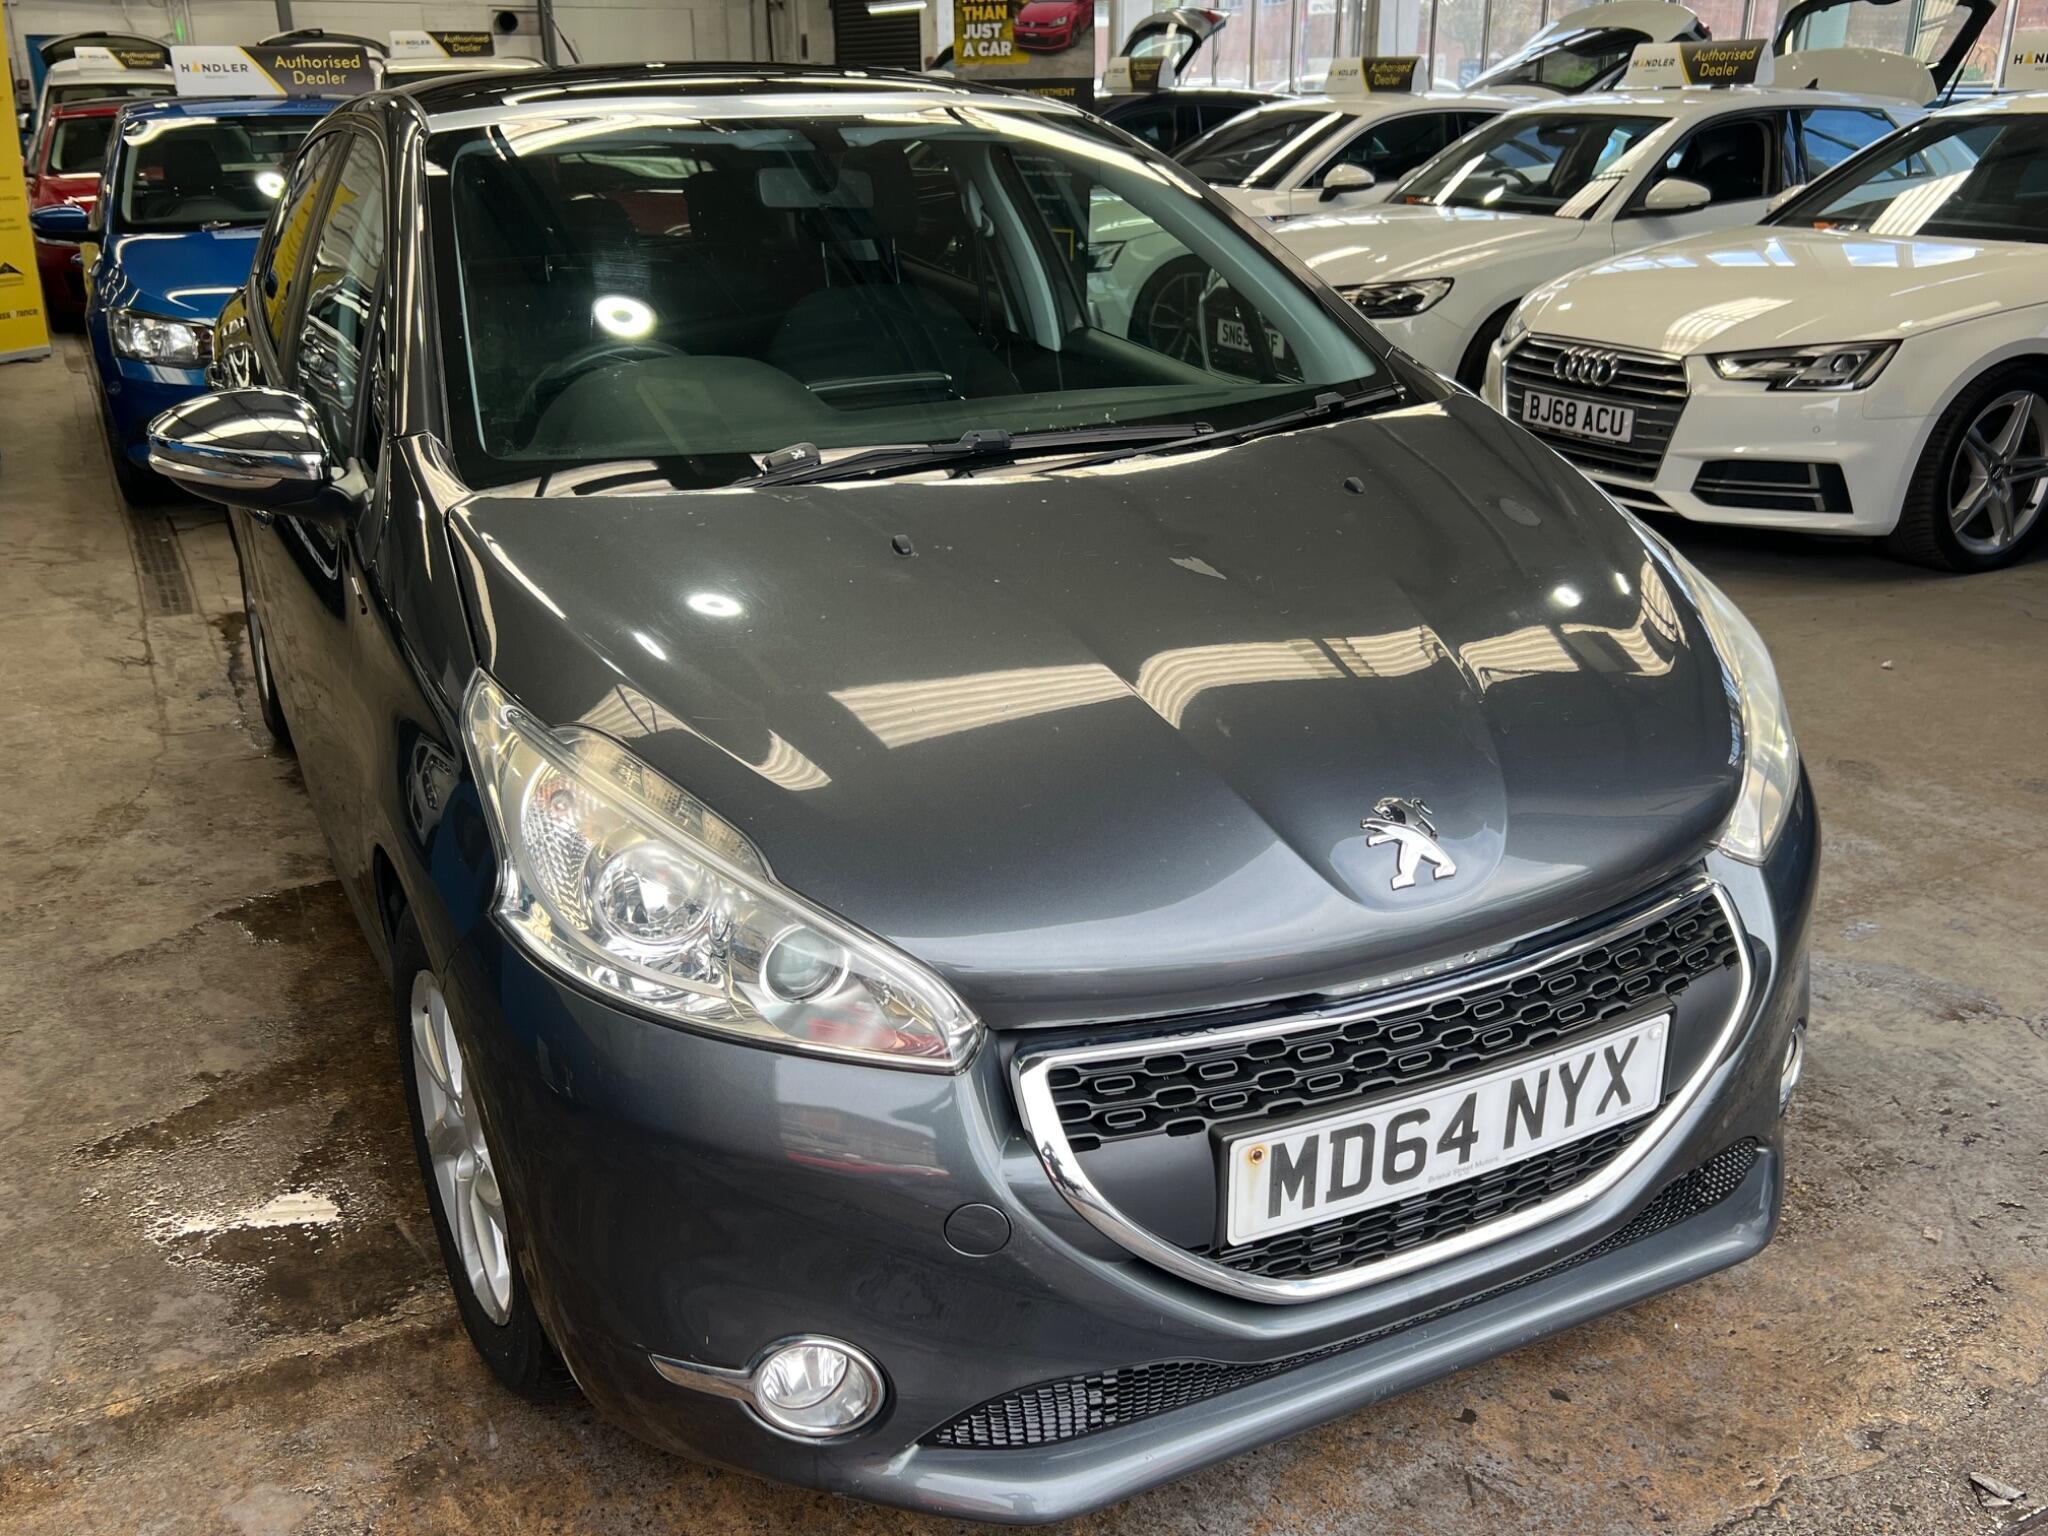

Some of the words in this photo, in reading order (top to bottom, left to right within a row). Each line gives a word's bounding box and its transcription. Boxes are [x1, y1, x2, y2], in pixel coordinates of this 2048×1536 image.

[962, 5, 1007, 20] THAN
[963, 23, 1002, 39] JUST
[963, 42, 975, 57] A
[978, 41, 1012, 56] CAR
[1692, 47, 1757, 62] Authorised
[274, 54, 361, 69] Authorised
[1700, 62, 1739, 77] Dealer
[292, 71, 347, 85] Dealer
[1529, 394, 1577, 427] BJ68
[1582, 405, 1625, 436] ACU
[1268, 1092, 1479, 1219] MD64
[1503, 1036, 1640, 1150] NYX
